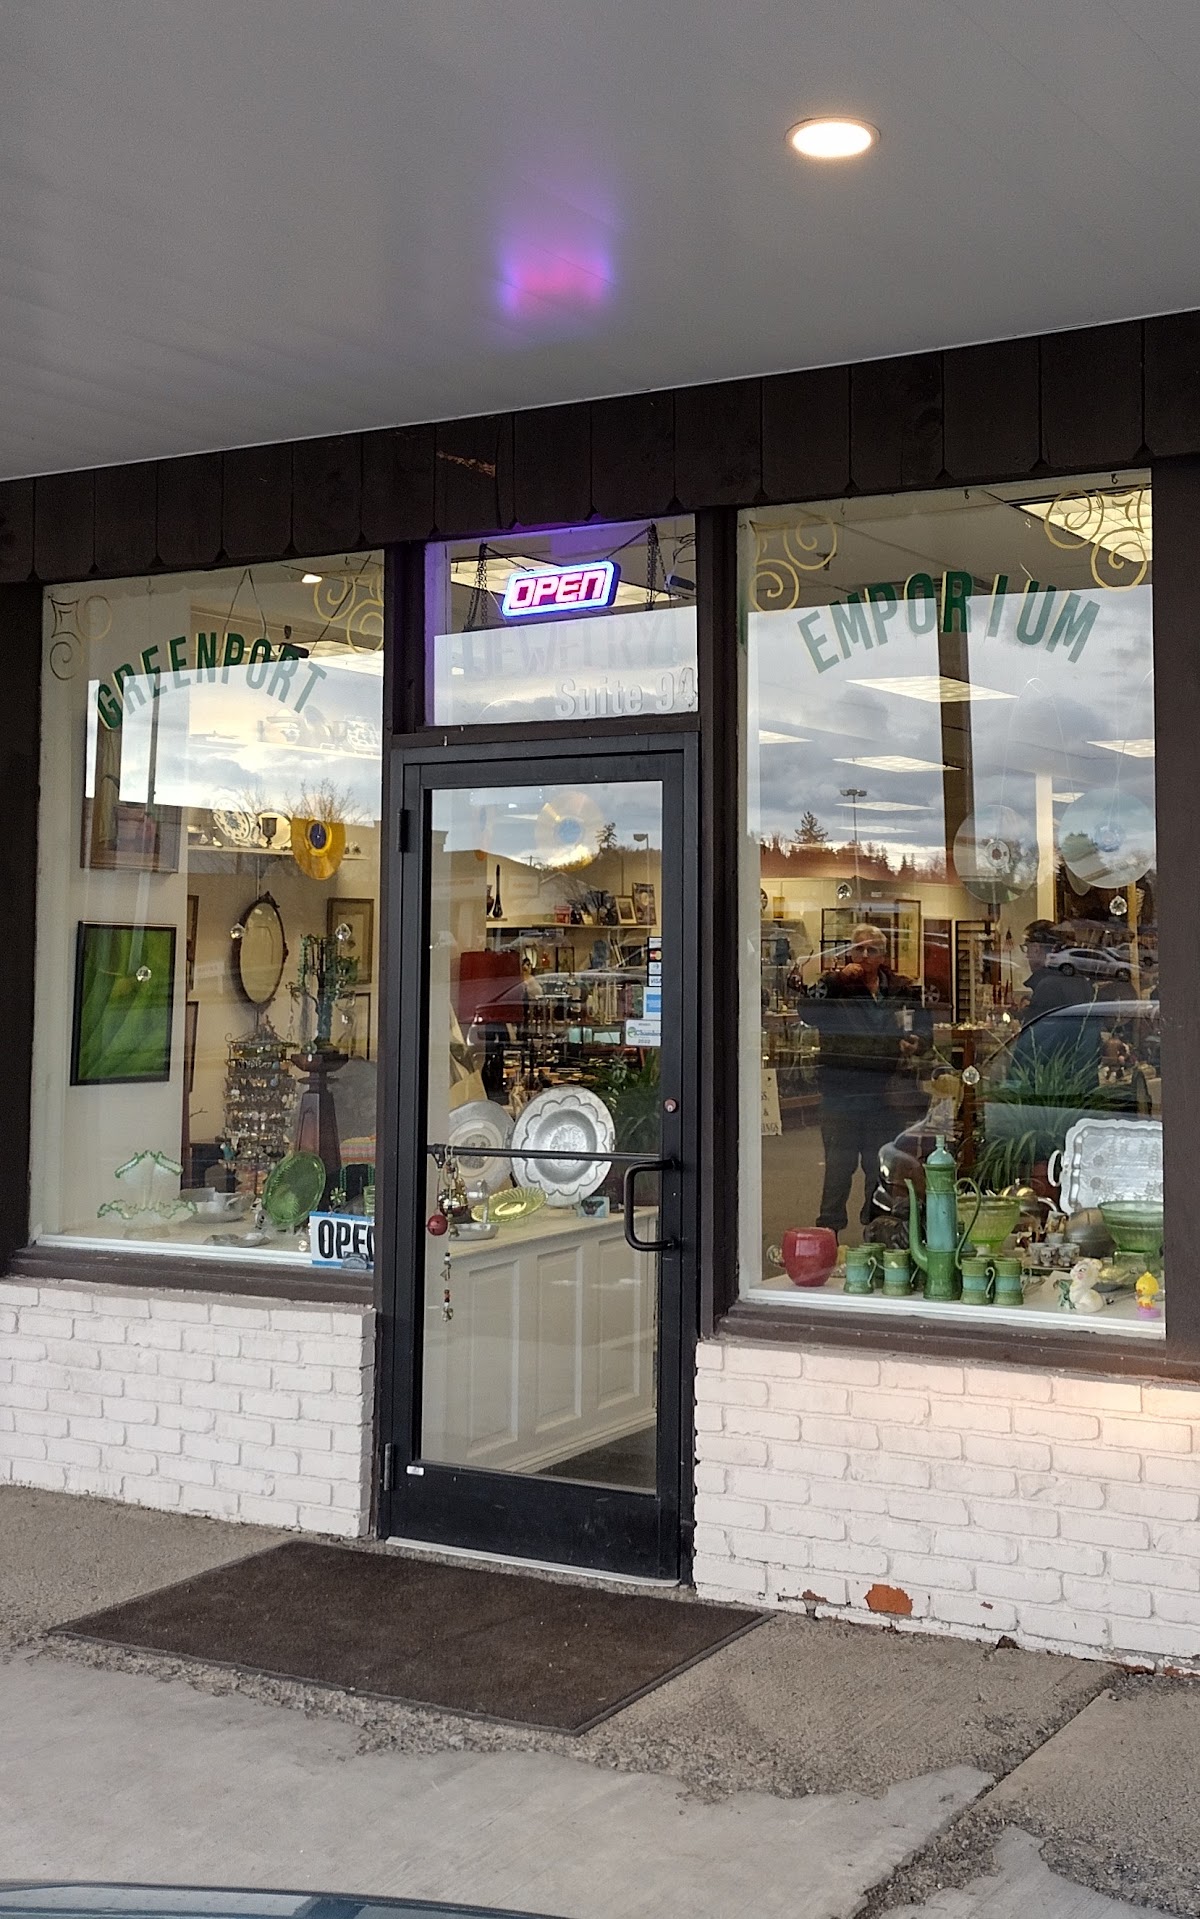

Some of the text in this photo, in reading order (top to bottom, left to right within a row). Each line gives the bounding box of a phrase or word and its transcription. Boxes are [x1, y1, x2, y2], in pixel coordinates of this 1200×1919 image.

[509, 568, 608, 610] OPEN
[796, 570, 1101, 674] EMPORIUM
[95, 631, 328, 731] GREENPORT
[554, 675, 644, 717] Suite
